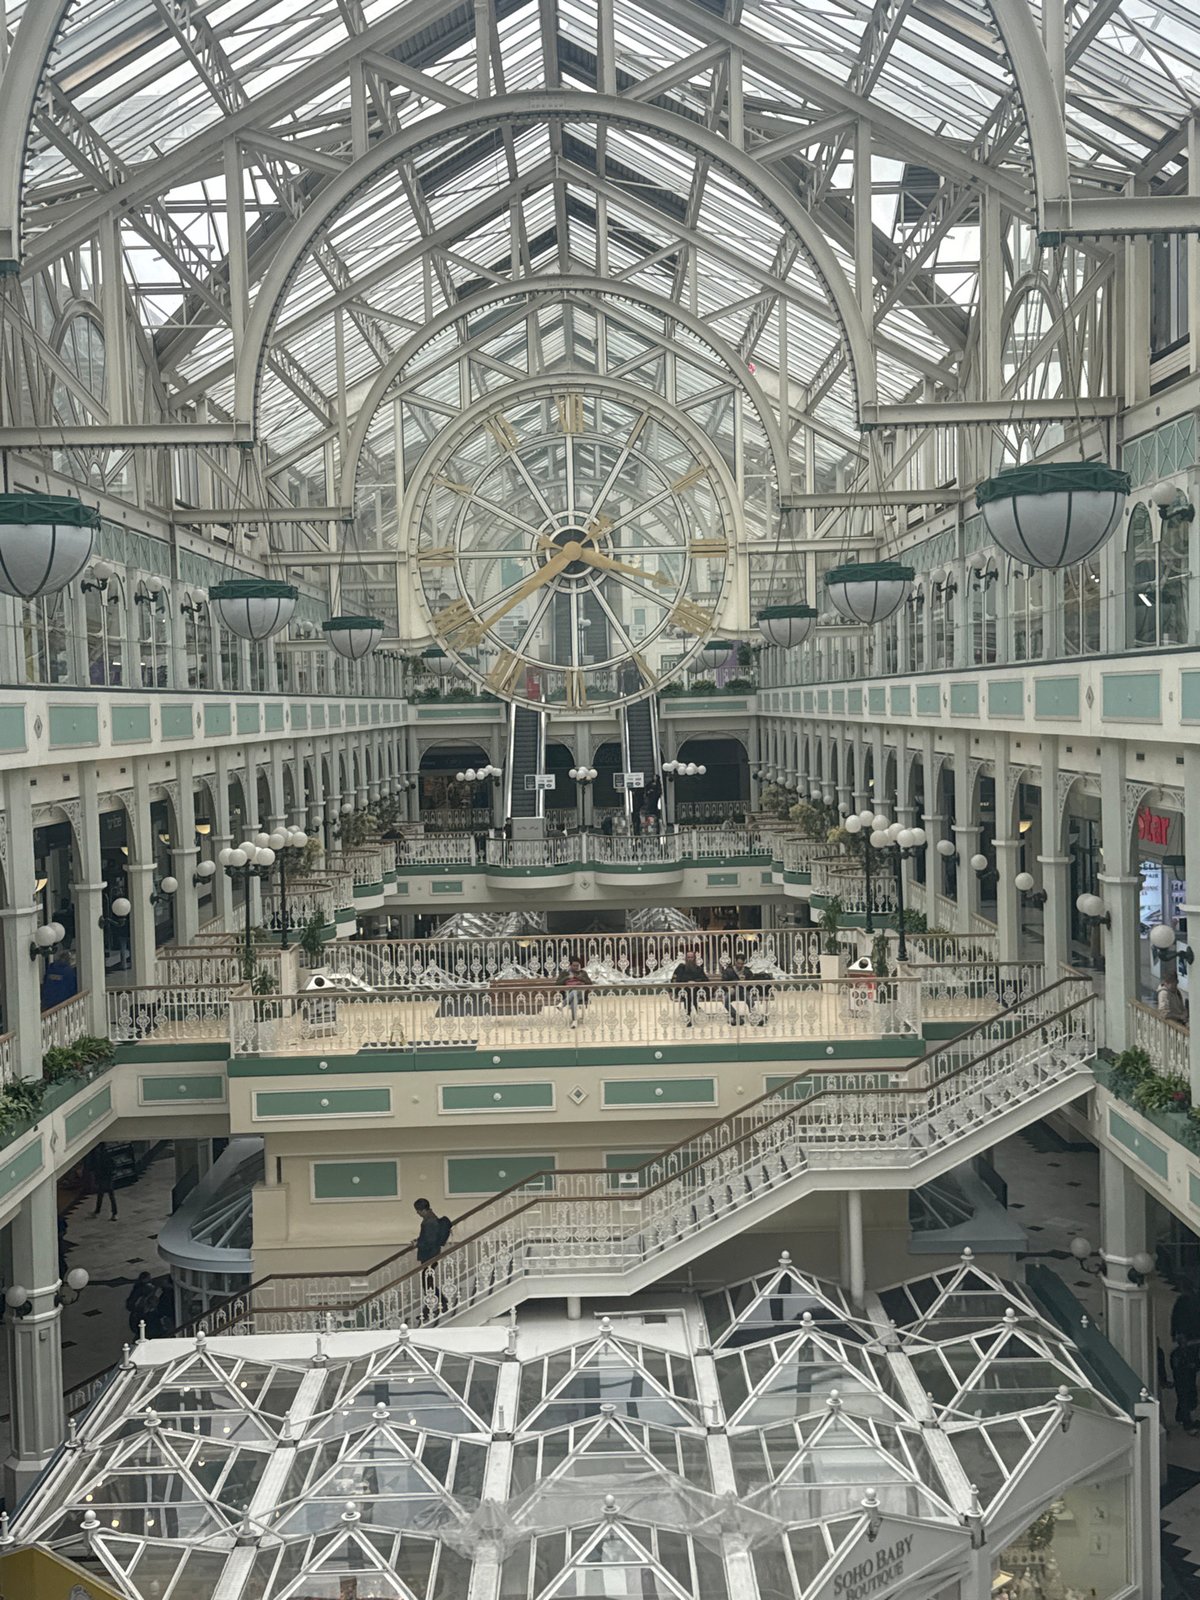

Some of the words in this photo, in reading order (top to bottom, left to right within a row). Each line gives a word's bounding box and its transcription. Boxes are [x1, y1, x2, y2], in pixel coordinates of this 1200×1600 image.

[834, 1559, 874, 1596] SOHO
[876, 1533, 914, 1571] BABY
[846, 1560, 904, 1600] BOUTIQUE
